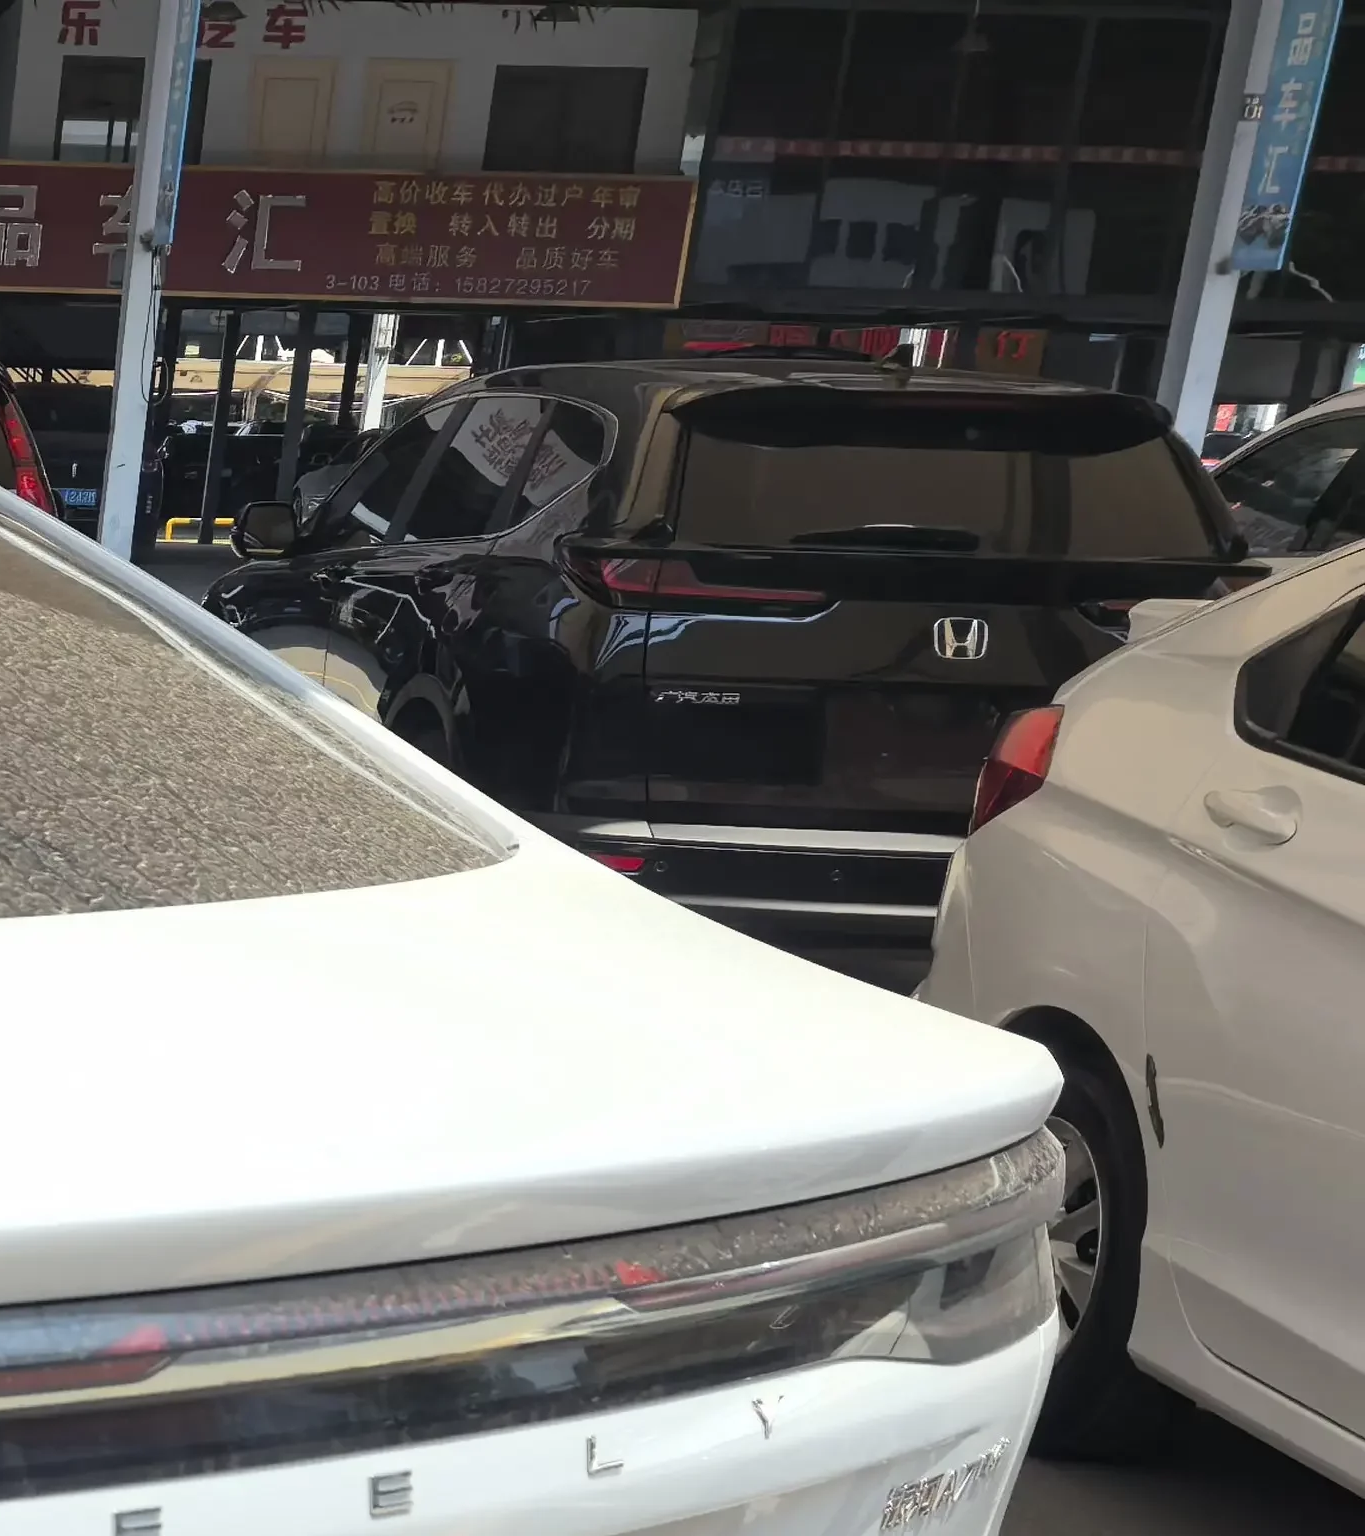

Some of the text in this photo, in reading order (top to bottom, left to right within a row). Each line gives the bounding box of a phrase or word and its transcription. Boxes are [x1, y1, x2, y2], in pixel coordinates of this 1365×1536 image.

[367, 211, 637, 241] 置换 转入转出 分期
[374, 242, 621, 271] 高端服务 品质好车
[325, 274, 380, 292] 3-103
[455, 276, 593, 297] 15827295217
